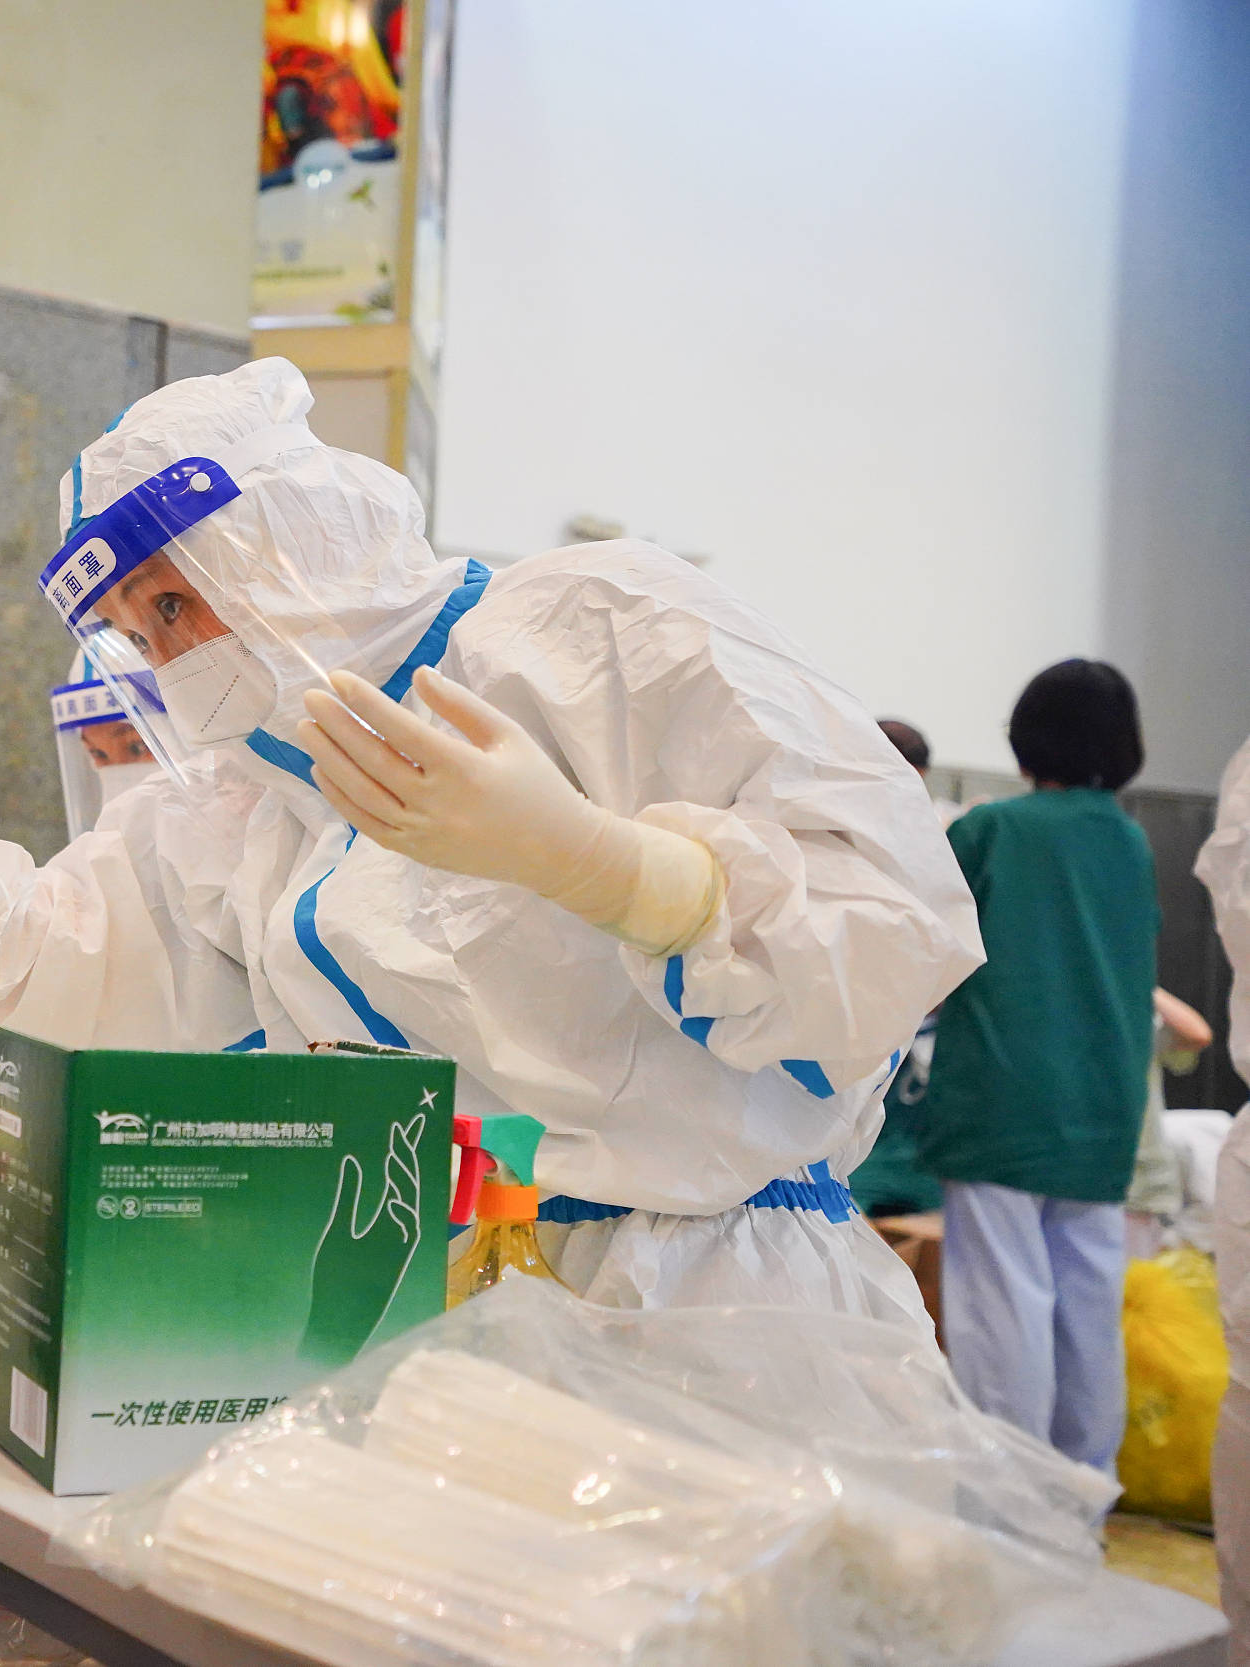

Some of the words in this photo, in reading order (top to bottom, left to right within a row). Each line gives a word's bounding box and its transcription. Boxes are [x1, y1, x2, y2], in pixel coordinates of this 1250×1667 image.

[91, 1397, 288, 1427] 一次性使用医用
